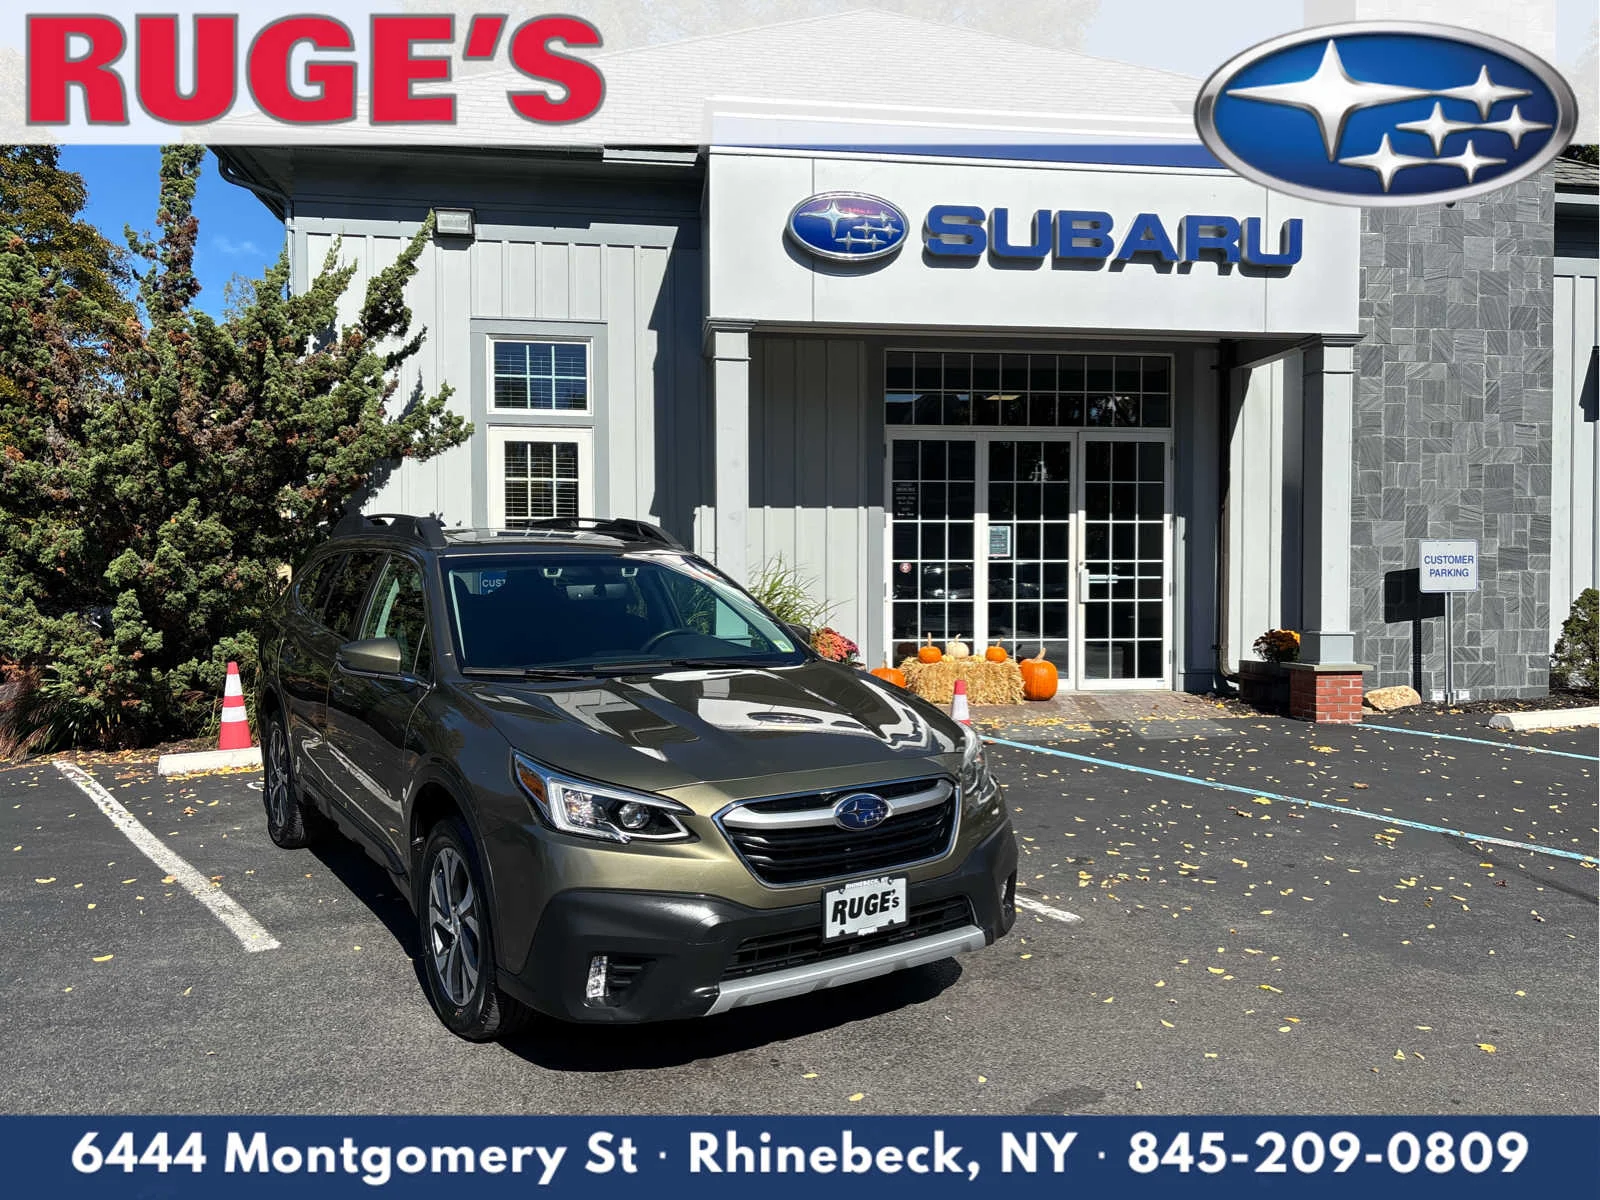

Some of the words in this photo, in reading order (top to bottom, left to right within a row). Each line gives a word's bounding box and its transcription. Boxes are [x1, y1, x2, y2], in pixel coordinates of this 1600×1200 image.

[923, 205, 1304, 266] SUBARU
[1424, 555, 1475, 565] CUSTOMER
[1429, 568, 1470, 577] PARKING
